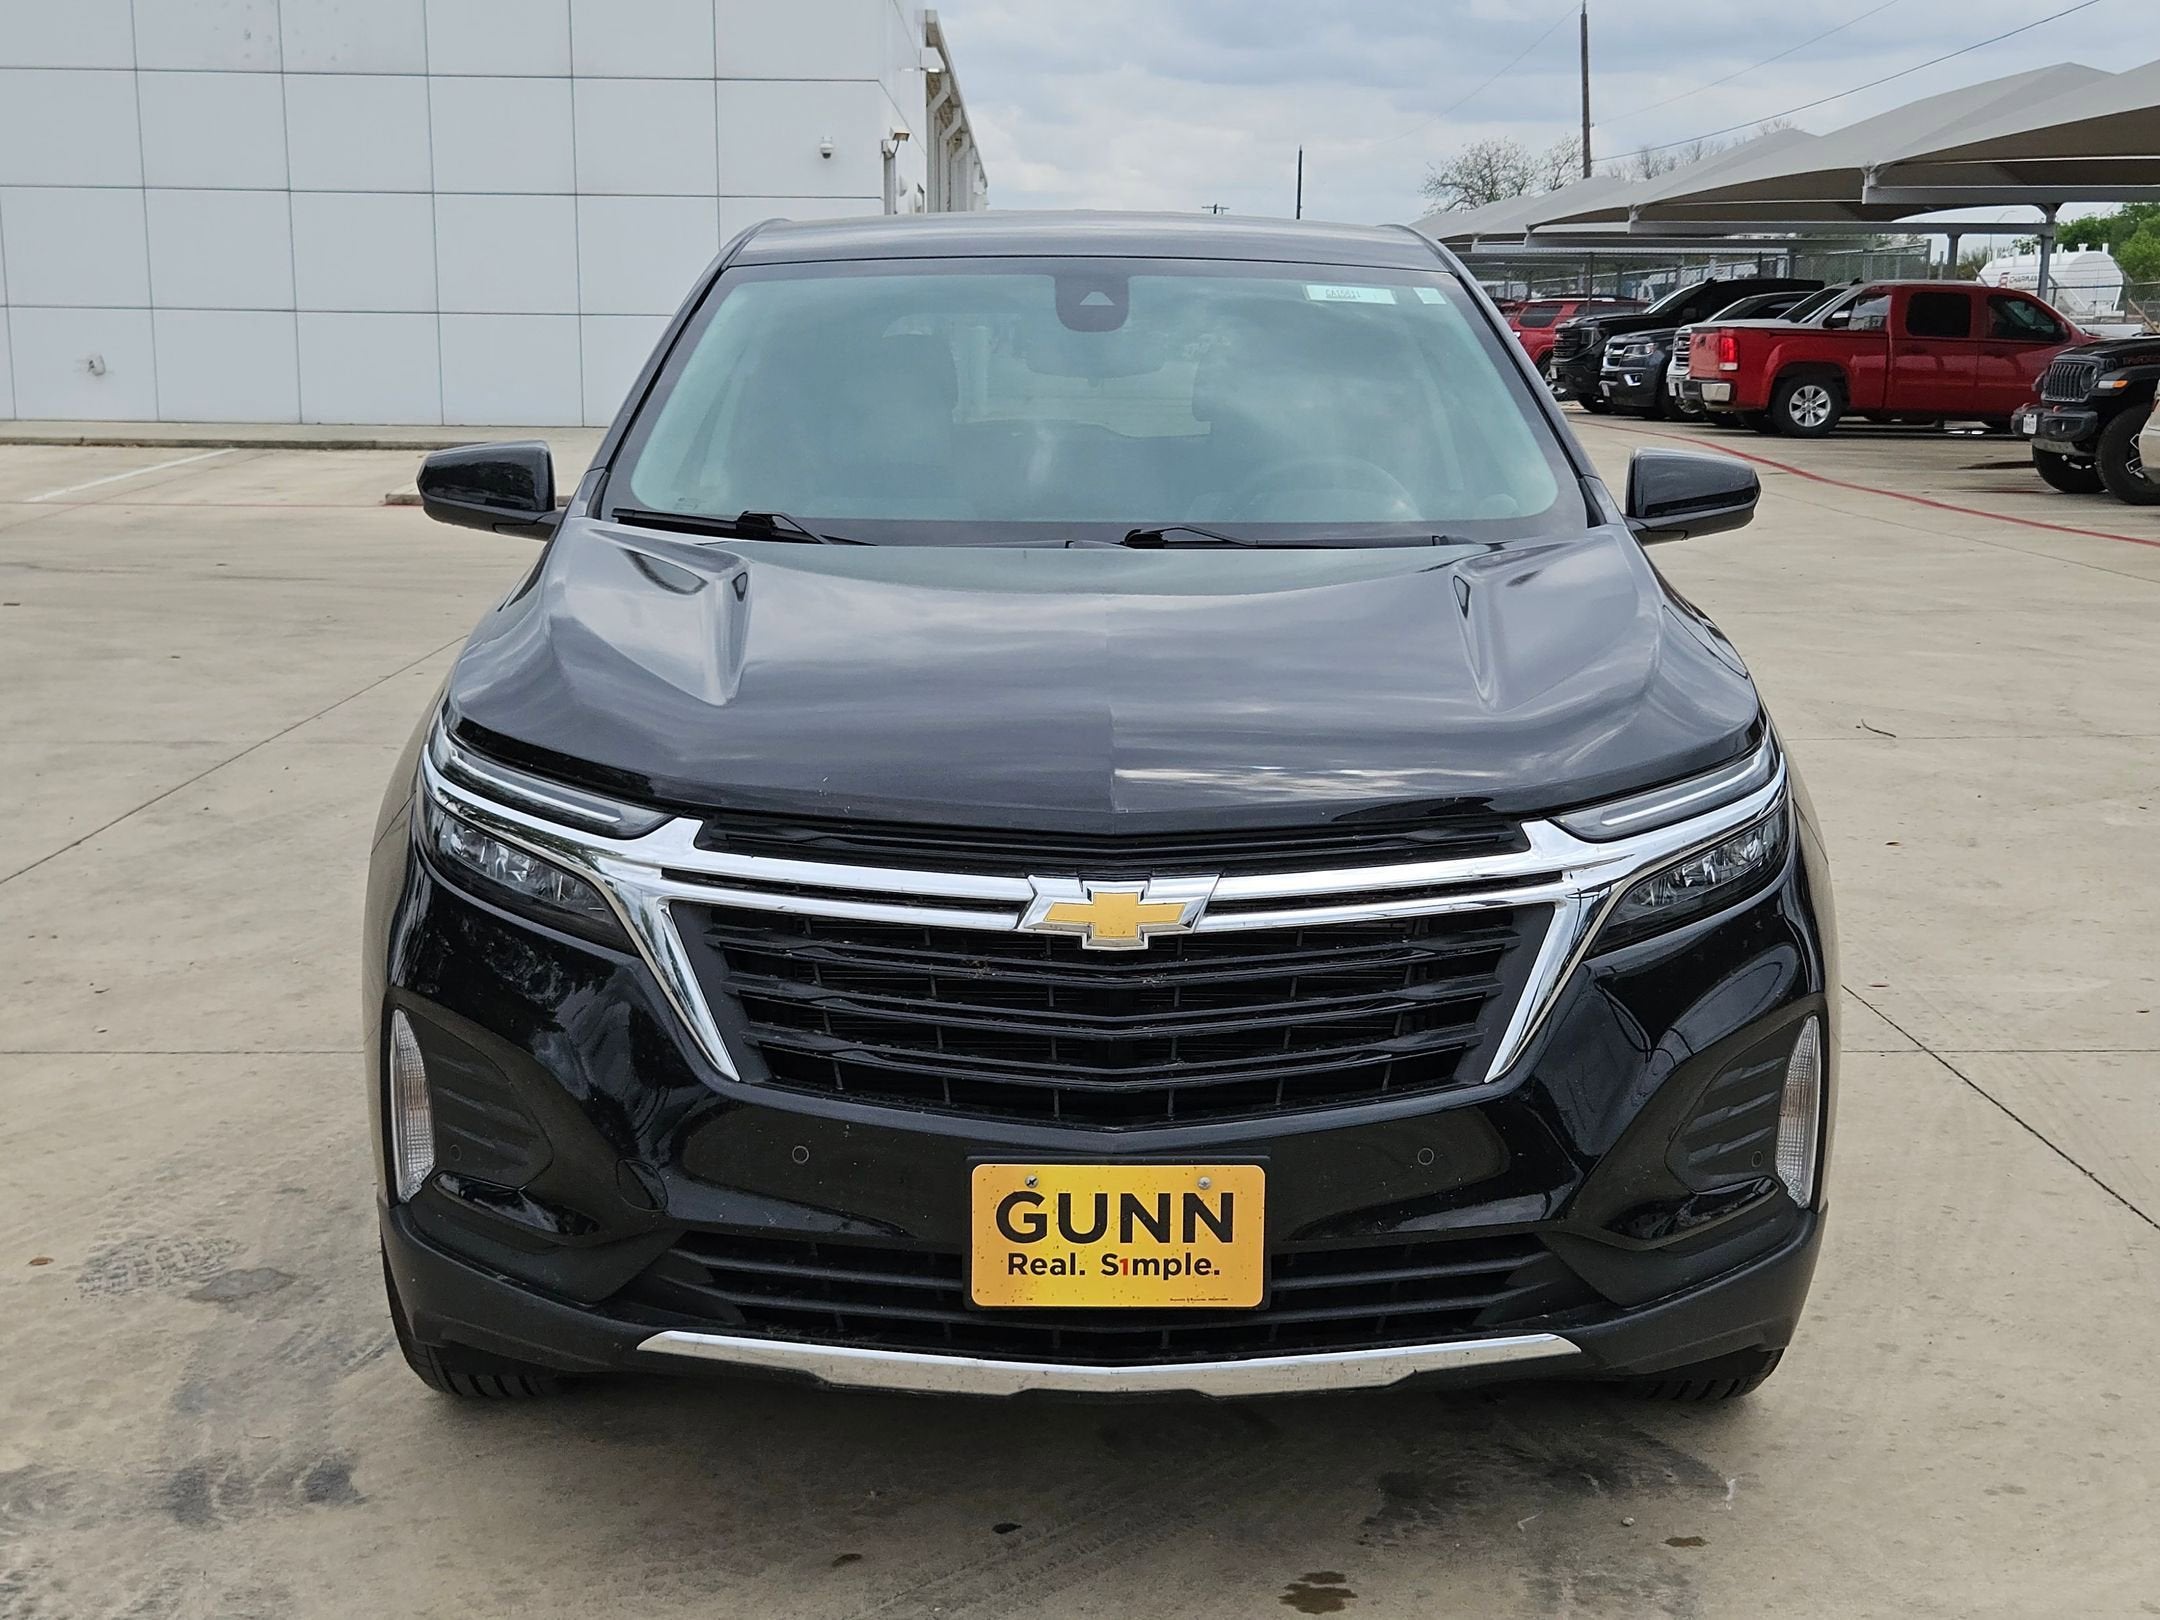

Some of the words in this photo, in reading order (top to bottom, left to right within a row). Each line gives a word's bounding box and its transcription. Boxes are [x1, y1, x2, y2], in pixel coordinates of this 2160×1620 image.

[995, 1190, 1234, 1244] GUNN
[1008, 1252, 1086, 1276] Real.
[1100, 1252, 1221, 1281] S1mple.
